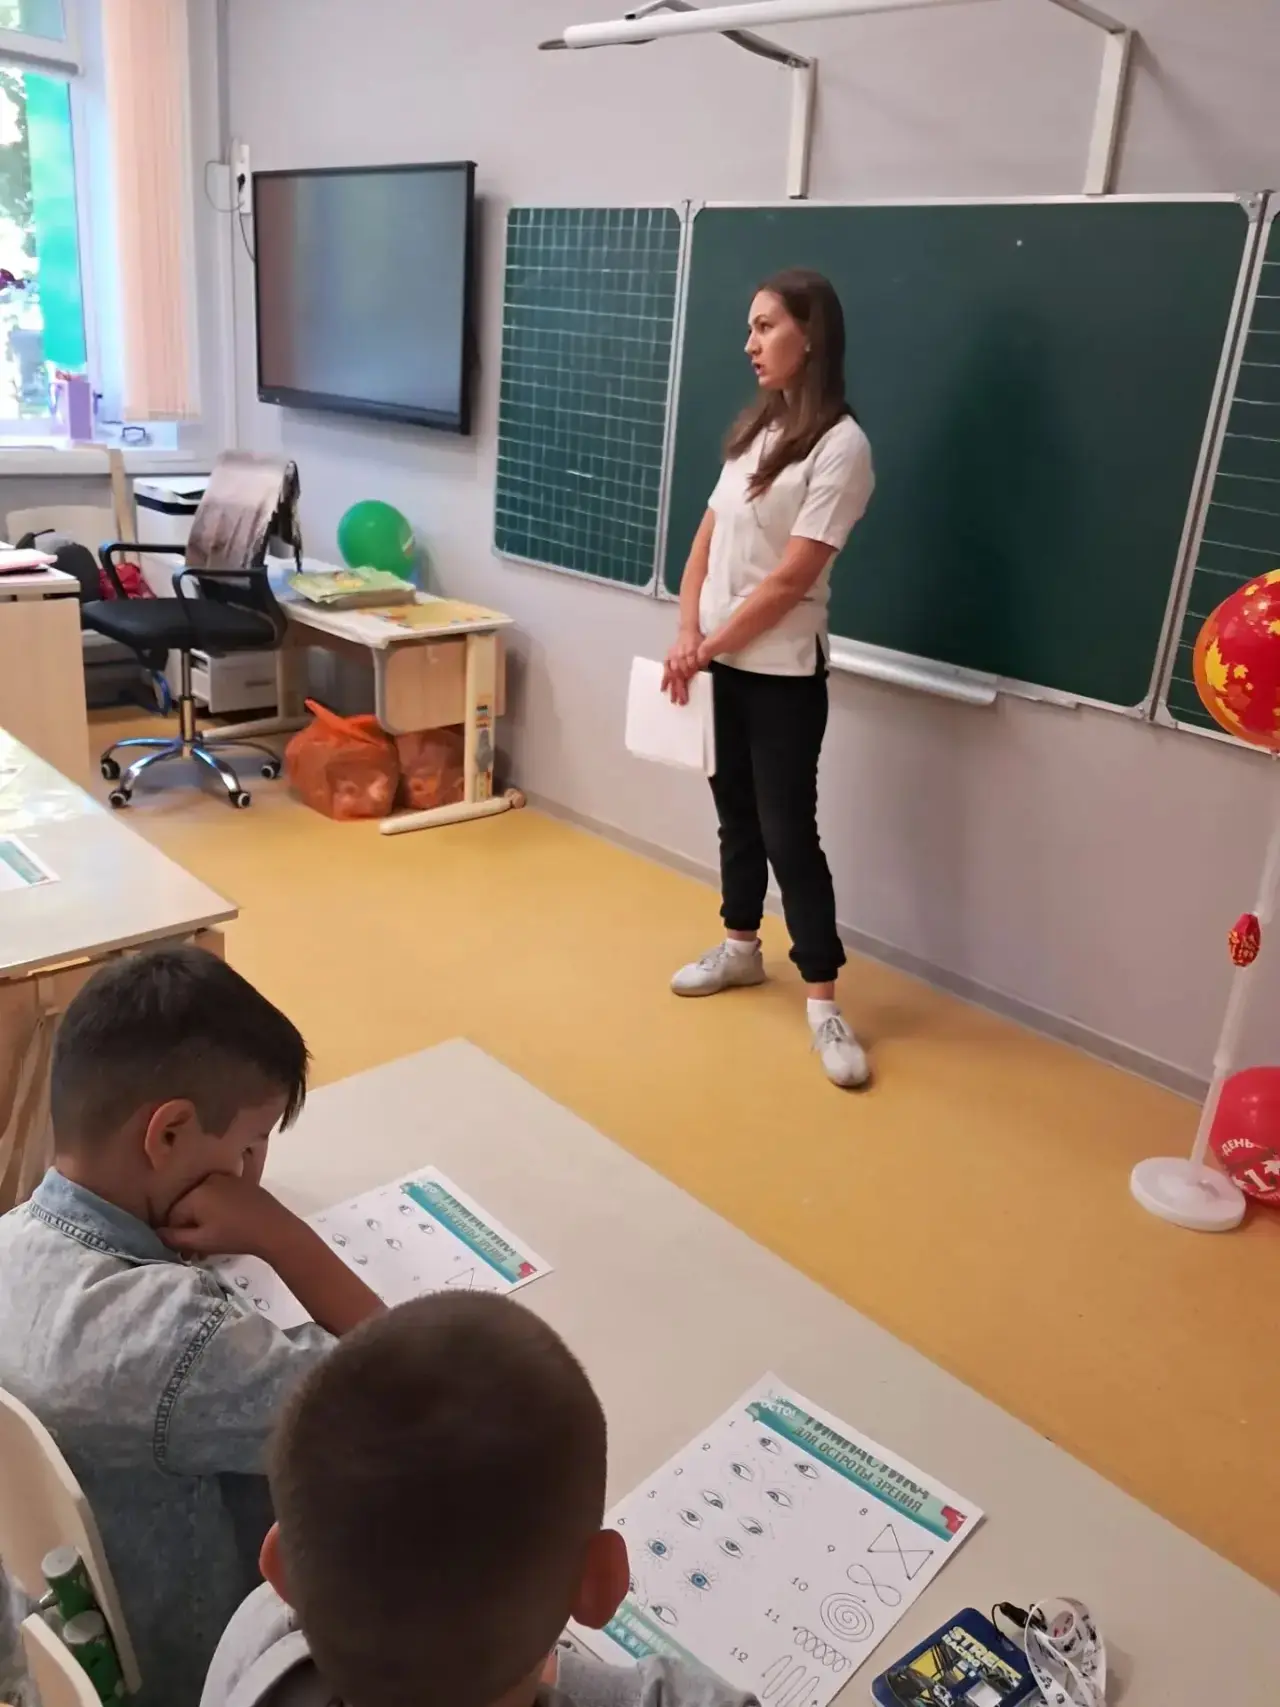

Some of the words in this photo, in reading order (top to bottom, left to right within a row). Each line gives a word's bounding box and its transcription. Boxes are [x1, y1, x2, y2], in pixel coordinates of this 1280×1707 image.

[1222, 1138, 1254, 1156] ДЕНЬ
[793, 1425, 818, 1446] ДЛЯ
[818, 1442, 873, 1482] ОСТРОТЫ
[874, 1476, 923, 1513] ЗРЕНИЯ
[791, 1576, 809, 1592] 10
[765, 1608, 781, 1624] 11
[729, 1647, 749, 1663] 12
[941, 1633, 980, 1668] RACING
